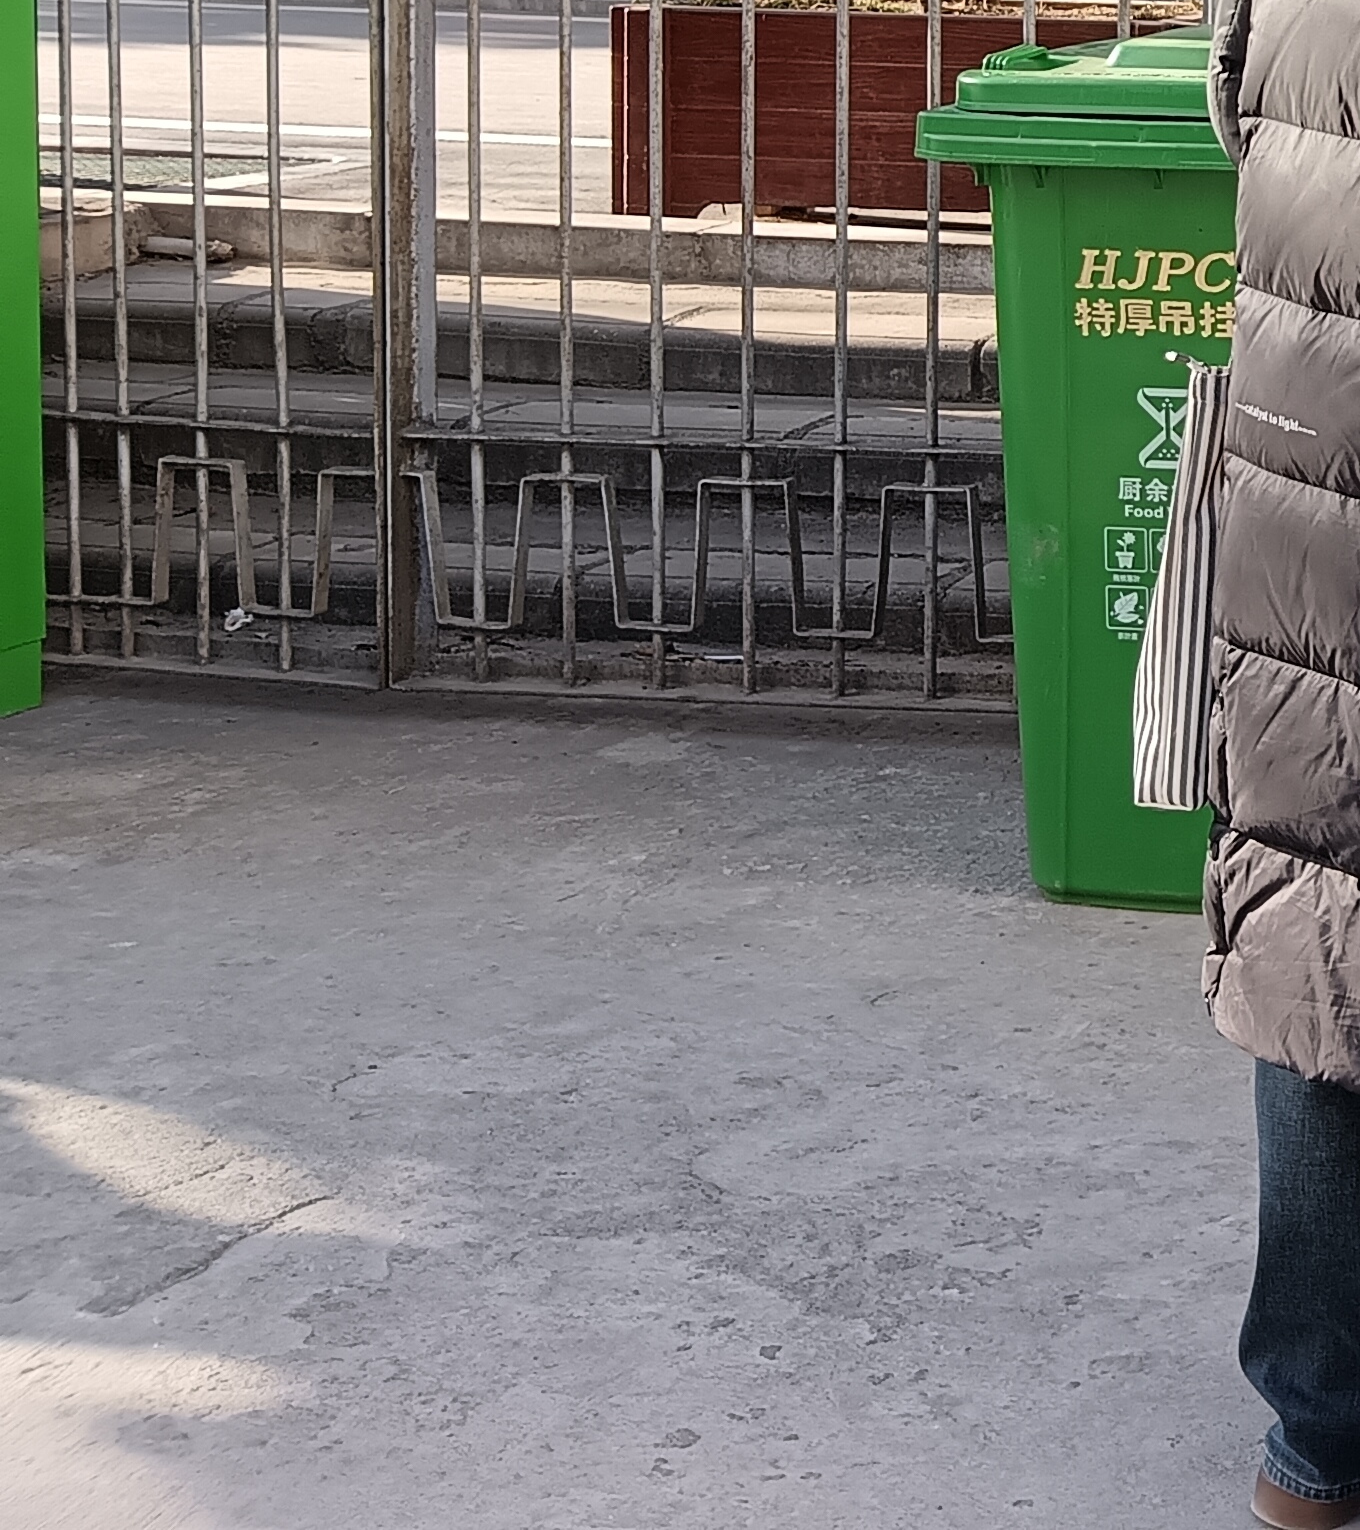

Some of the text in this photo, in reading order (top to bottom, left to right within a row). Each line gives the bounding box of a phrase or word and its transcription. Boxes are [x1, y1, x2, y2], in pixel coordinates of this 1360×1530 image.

[1075, 248, 1236, 293] HJPC
[1074, 298, 1236, 338] 特厚吊挂
[1118, 477, 1174, 502] 厨余
[1124, 504, 1164, 518] Food
